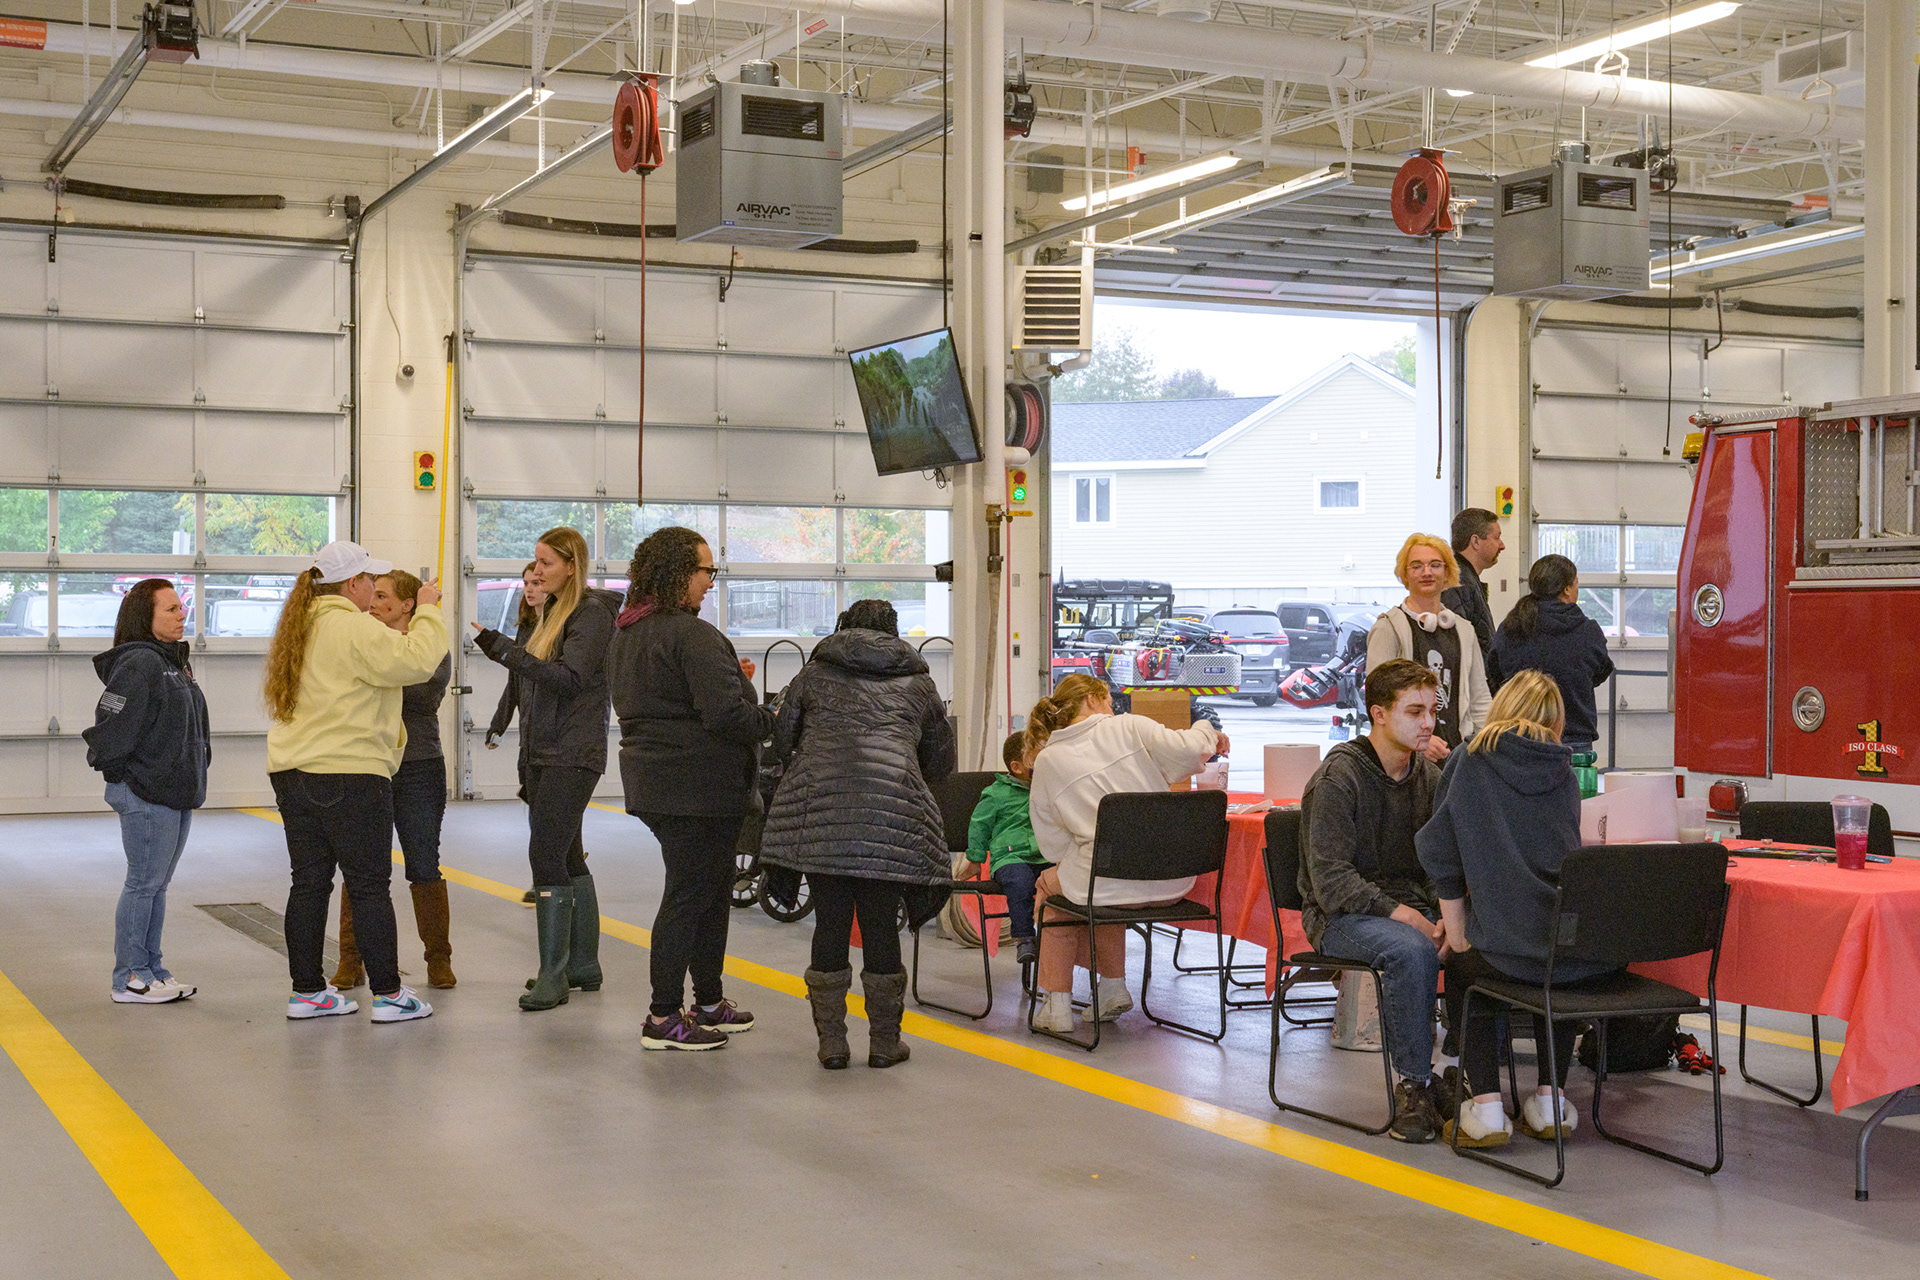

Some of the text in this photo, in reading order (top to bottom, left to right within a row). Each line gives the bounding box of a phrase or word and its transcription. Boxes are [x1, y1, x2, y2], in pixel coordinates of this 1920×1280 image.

[736, 203, 790, 216] AIRVAC
[1574, 264, 1612, 276] AIRVAC
[52, 536, 56, 546] 7
[720, 546, 726, 556] 8
[1062, 607, 1080, 624] U1
[1848, 742, 1898, 754] ISO CLASS
[1857, 719, 1886, 775] 1
